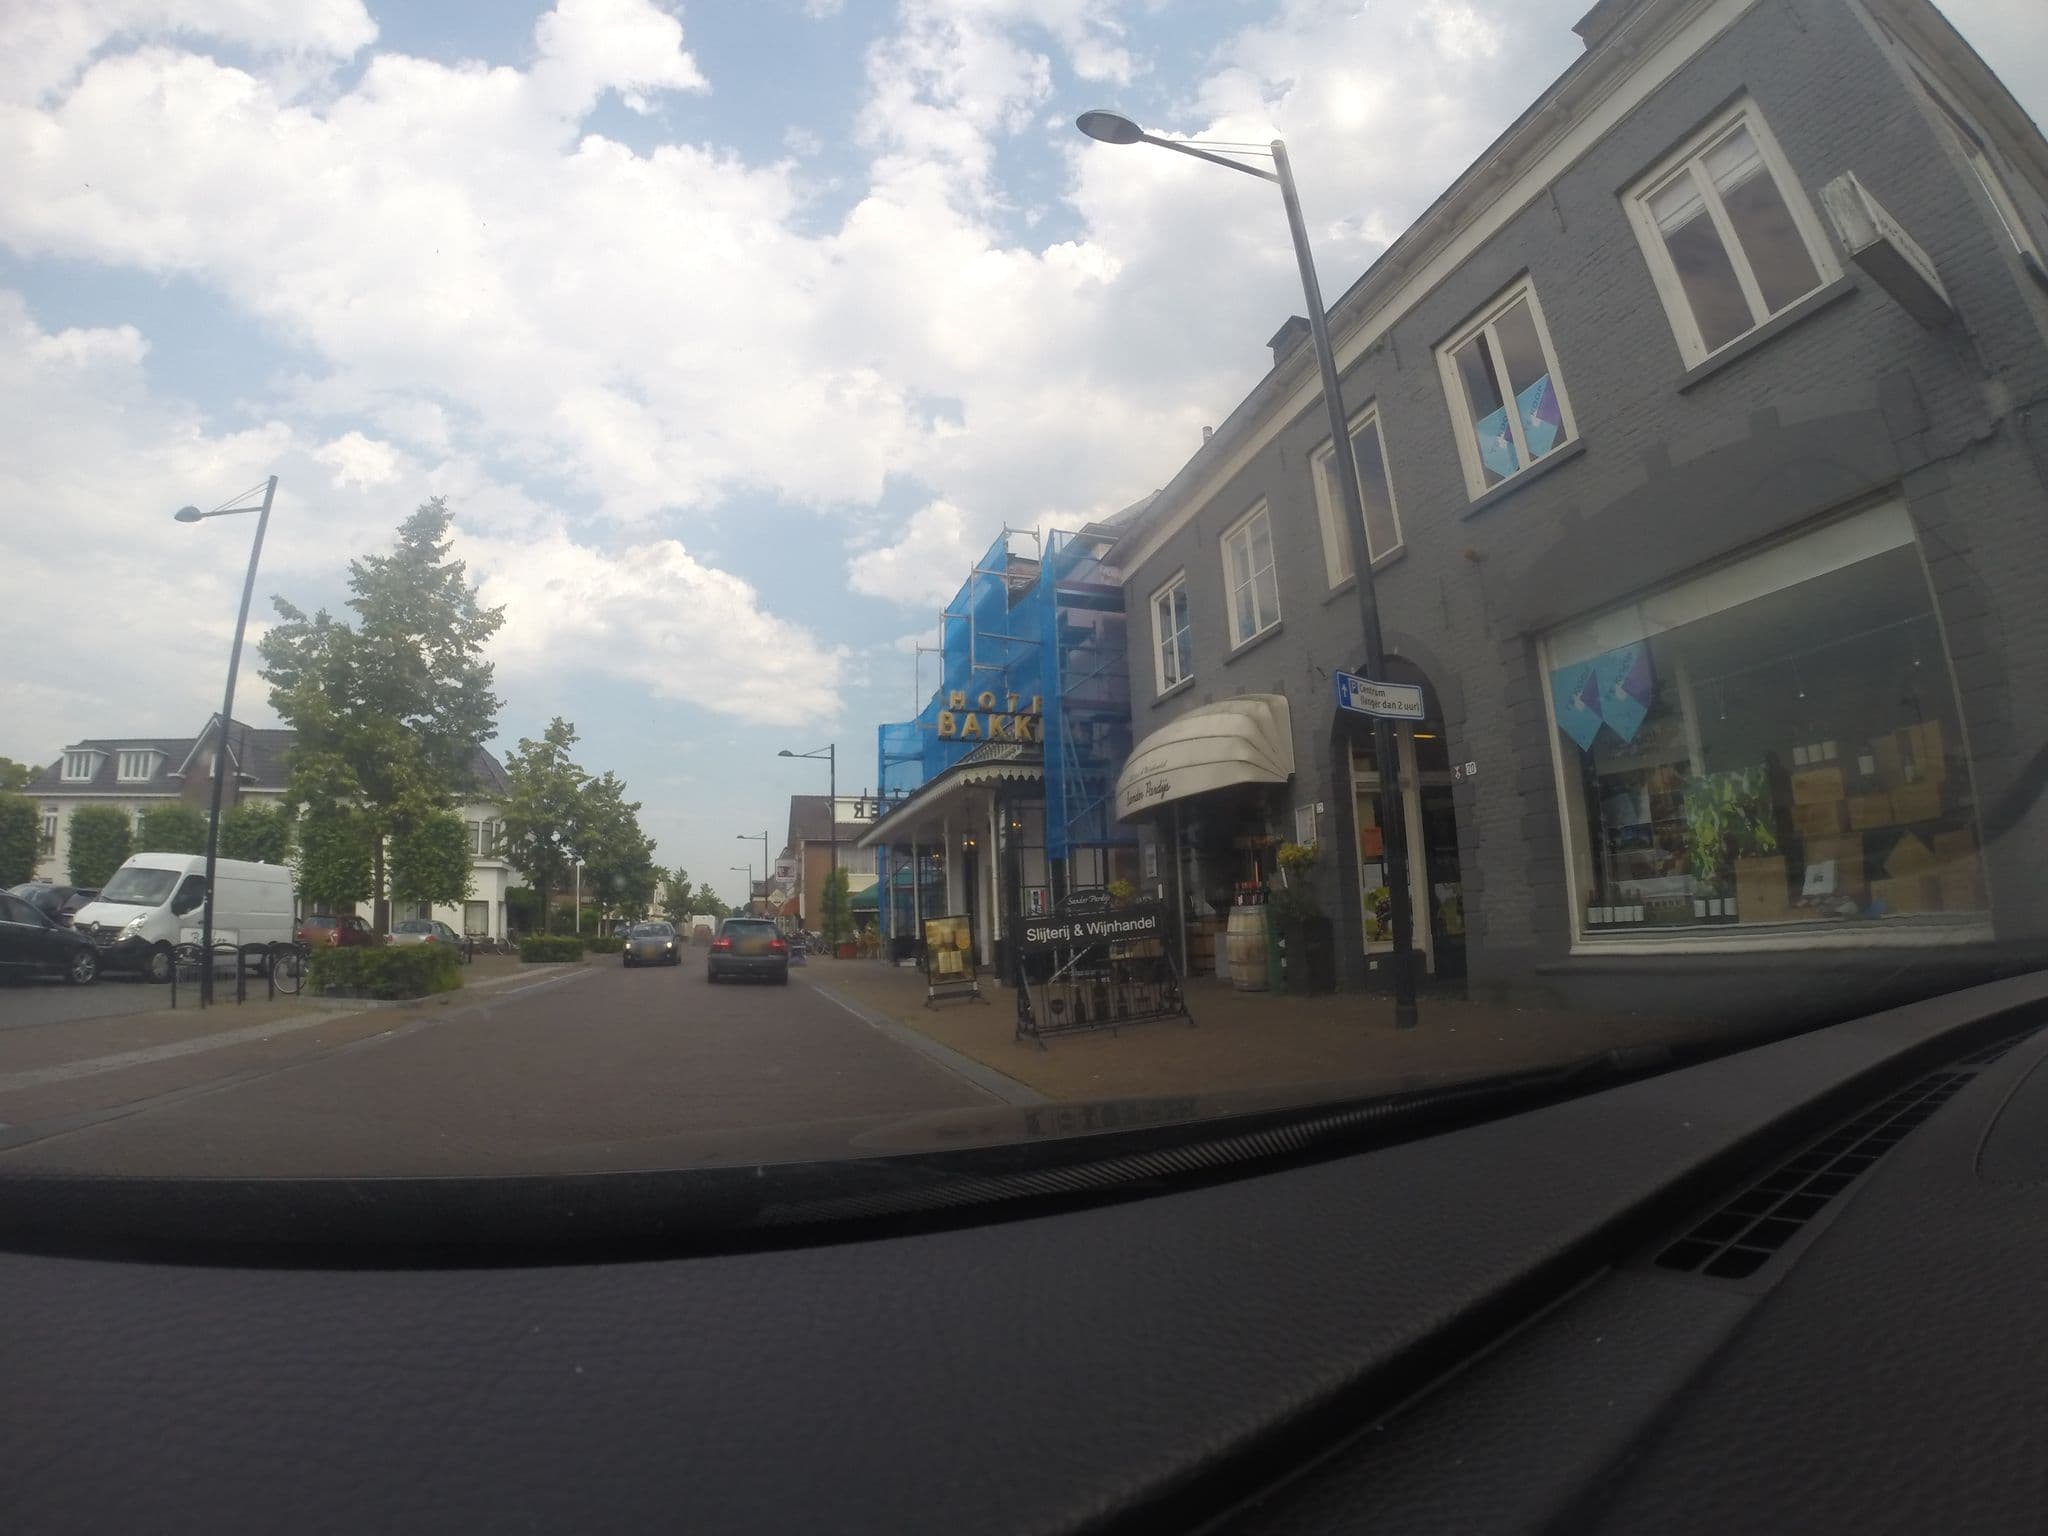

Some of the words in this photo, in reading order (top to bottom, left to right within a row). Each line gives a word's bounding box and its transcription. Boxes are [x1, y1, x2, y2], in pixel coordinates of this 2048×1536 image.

[1026, 926, 1070, 944] Slijterij
[1074, 924, 1084, 937] &
[1086, 915, 1156, 937] Wijnhandel
